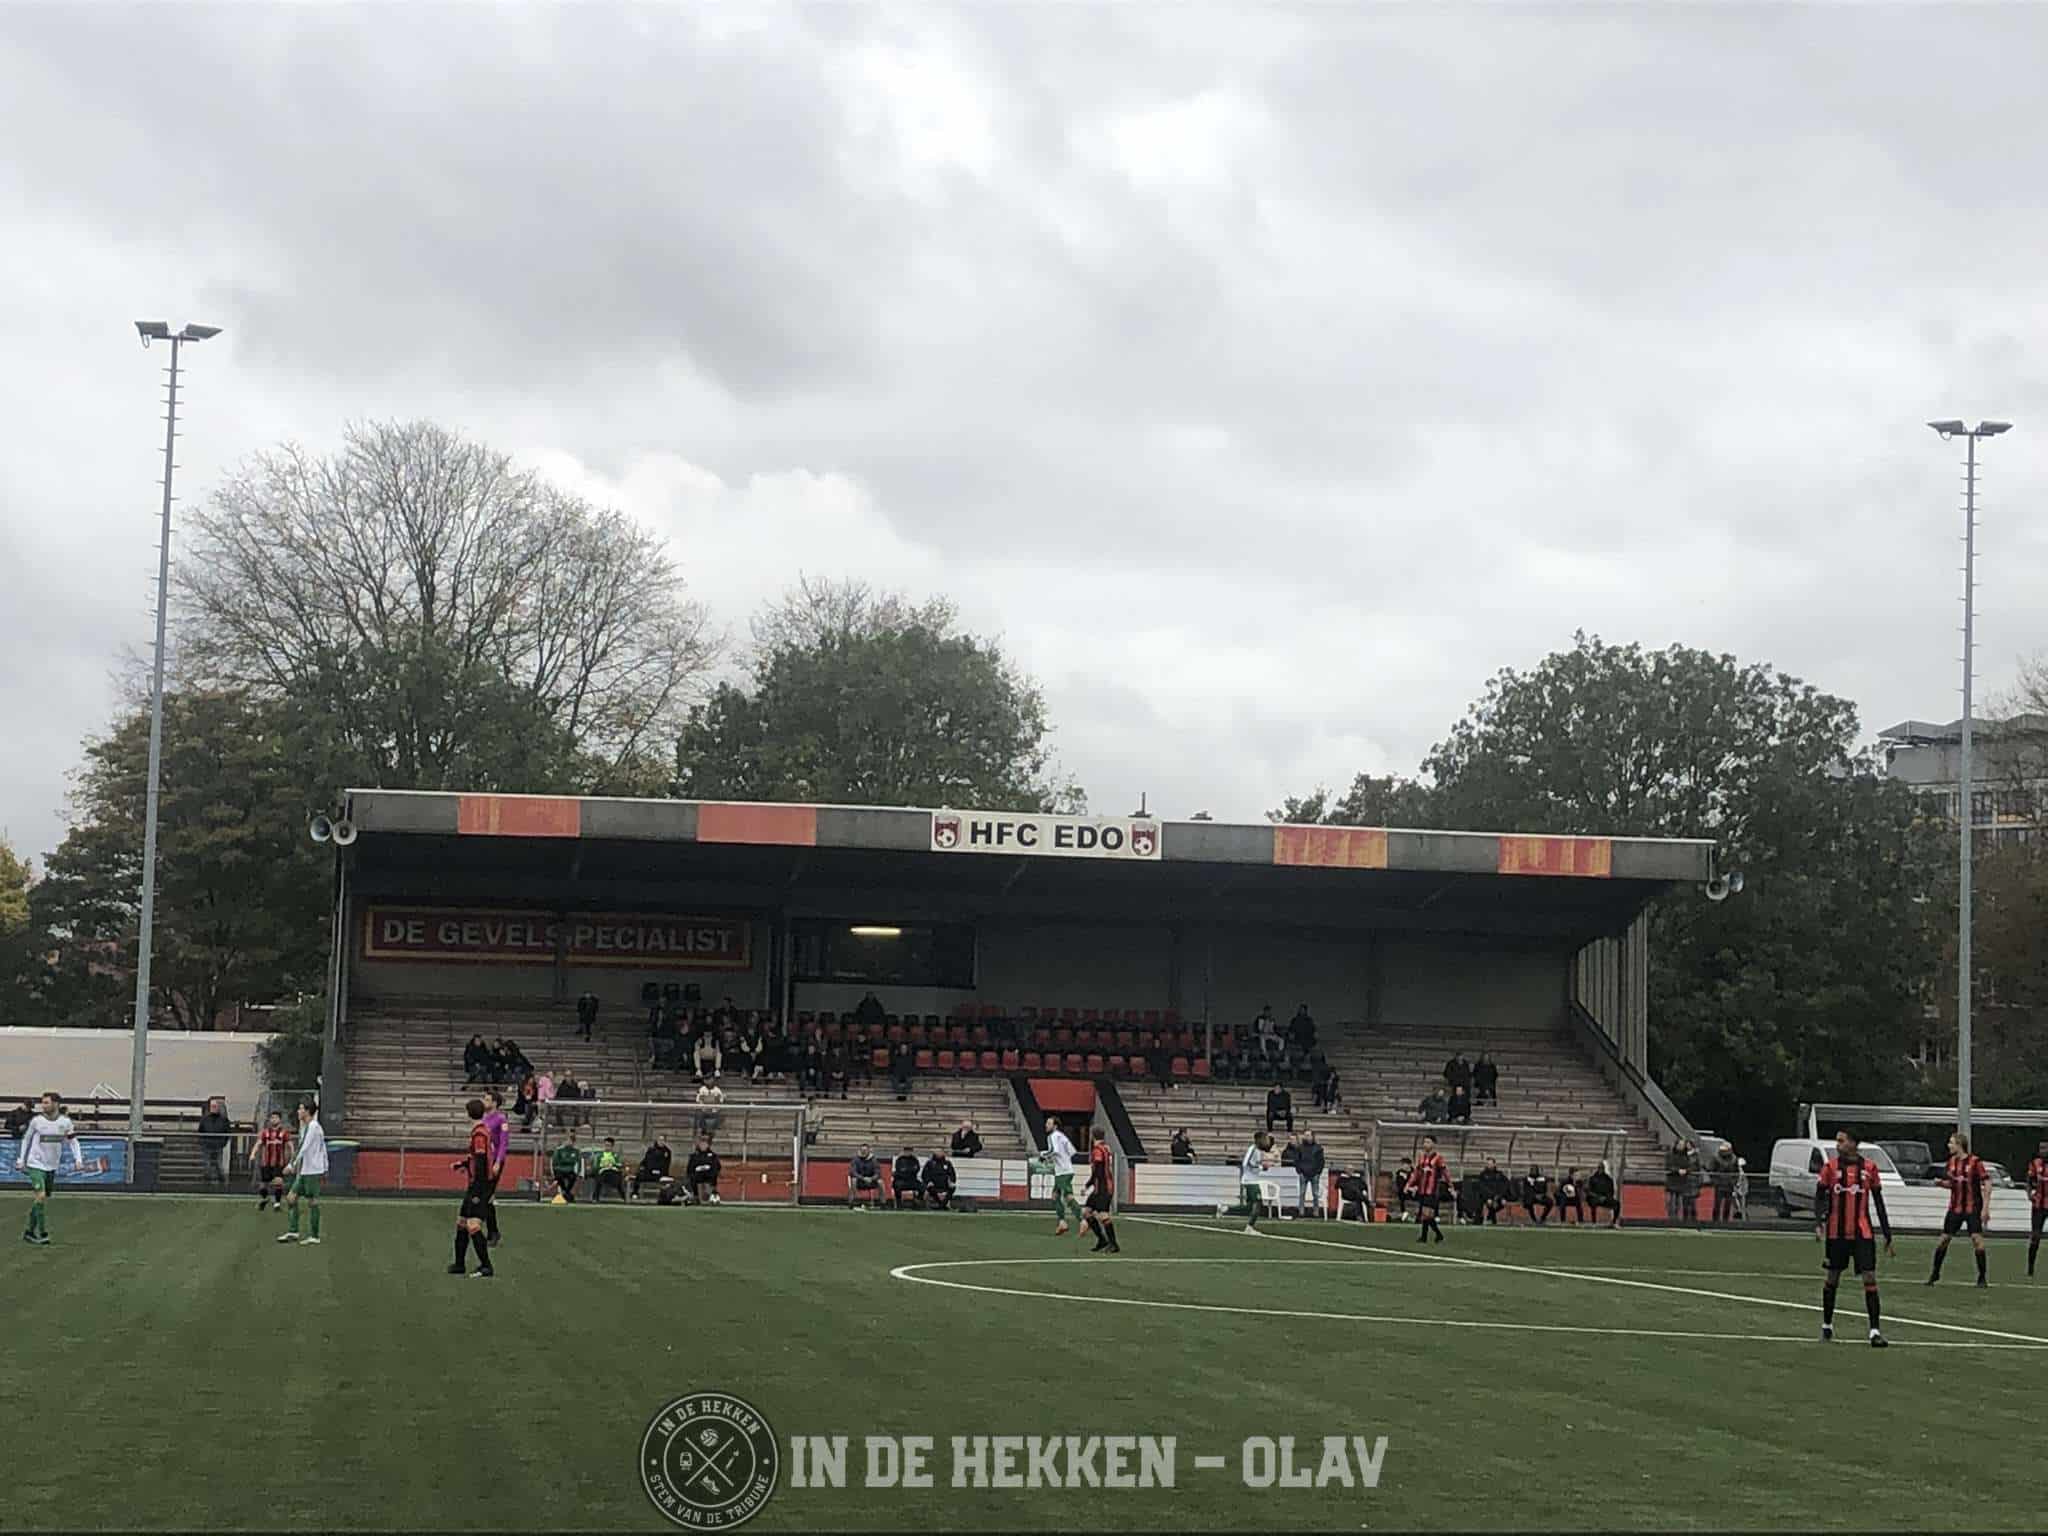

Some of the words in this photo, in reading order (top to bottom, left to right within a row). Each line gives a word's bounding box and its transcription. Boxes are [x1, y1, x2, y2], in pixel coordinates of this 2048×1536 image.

[970, 820, 1038, 846] HFC
[1054, 824, 1124, 850] EDO
[383, 919, 425, 944] DE
